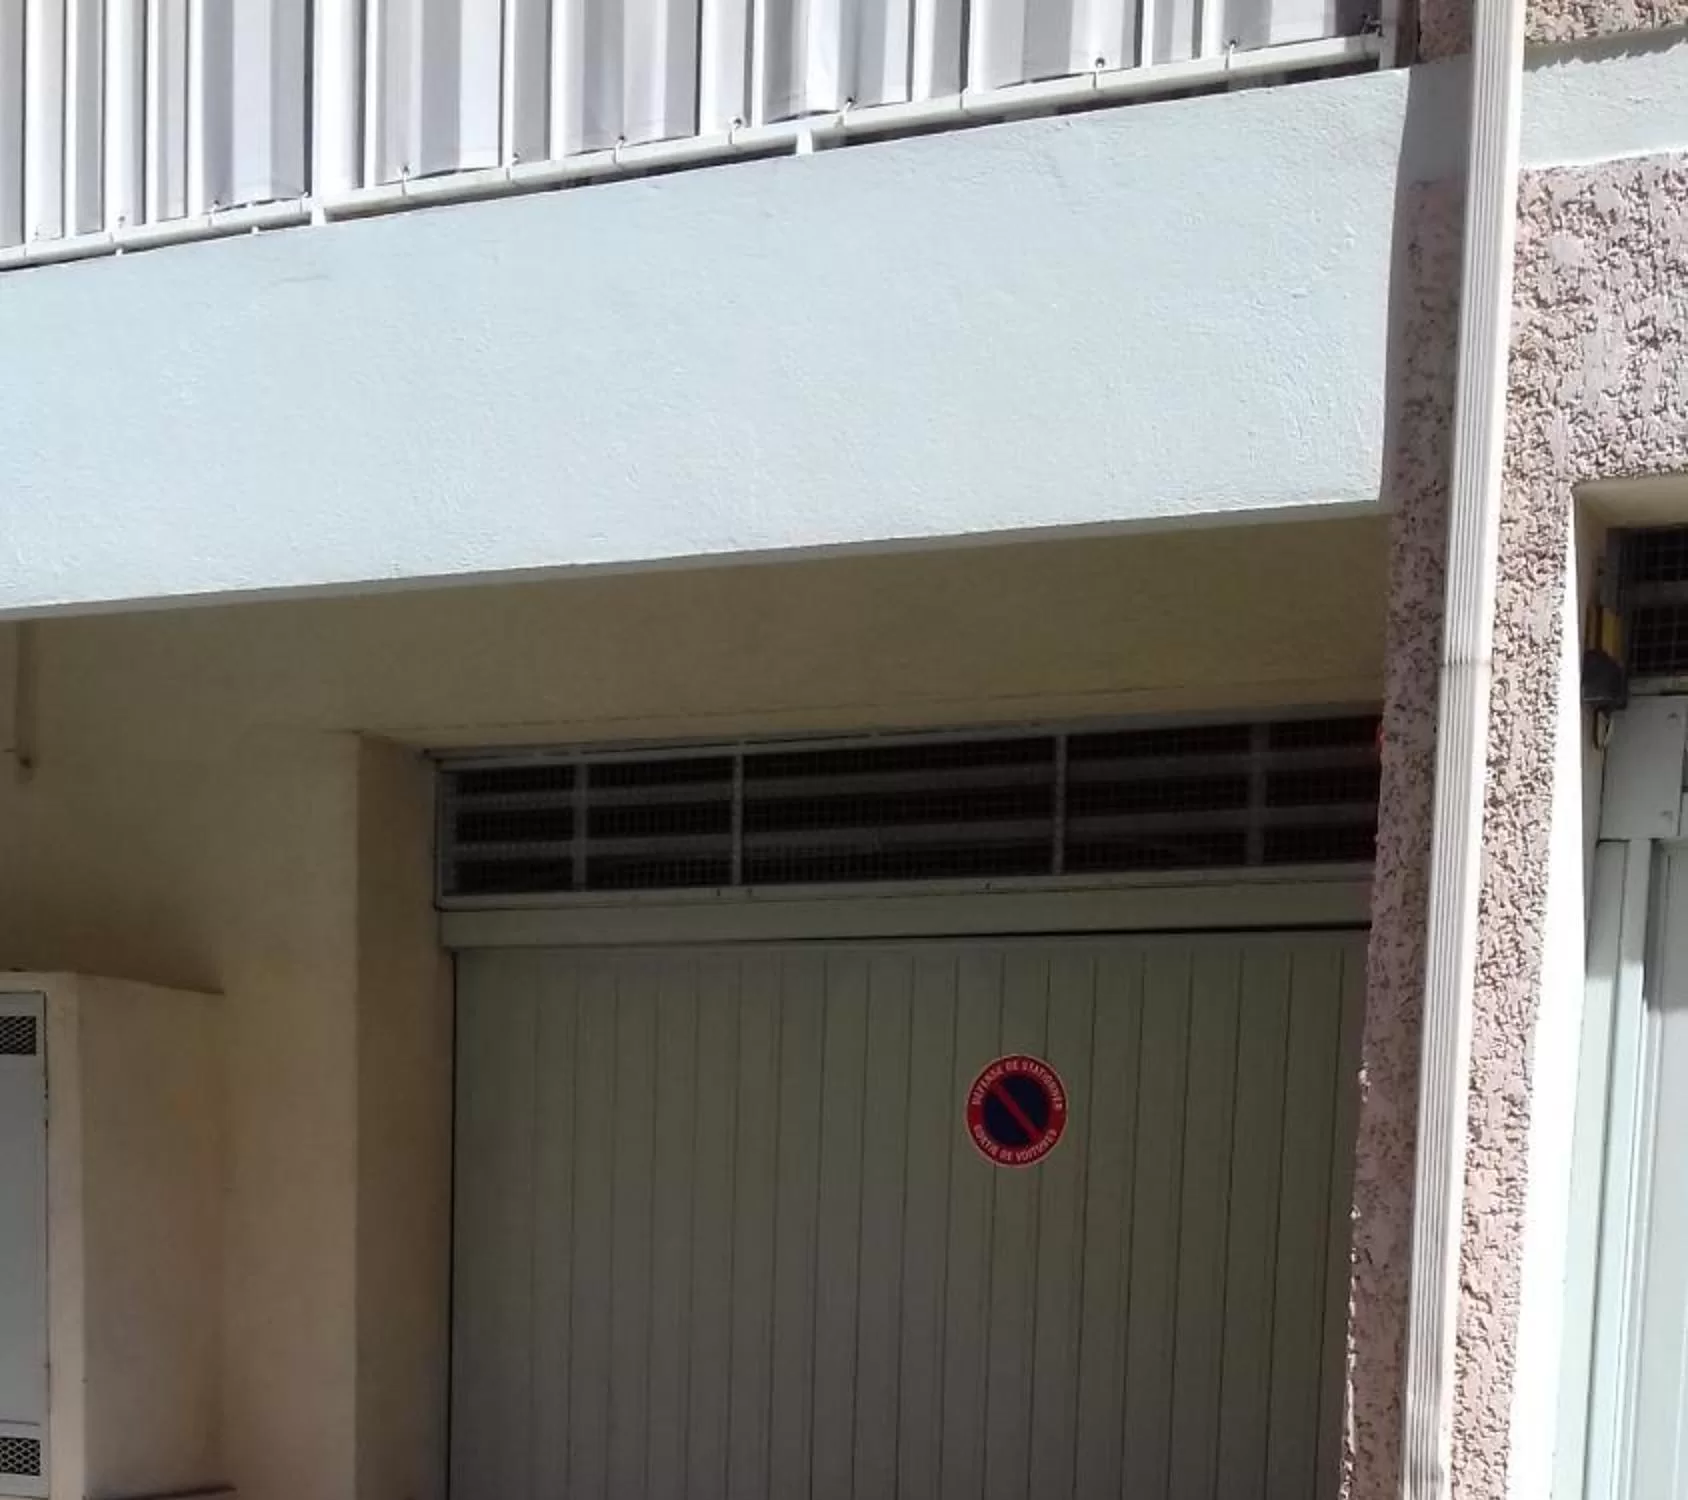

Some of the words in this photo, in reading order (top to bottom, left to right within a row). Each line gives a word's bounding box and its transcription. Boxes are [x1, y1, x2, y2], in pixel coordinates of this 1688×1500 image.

[1005, 1060, 1018, 1071] DE
[1021, 1060, 1063, 1111] STATIONNER
[973, 1124, 1000, 1157] SORTIE
[999, 1150, 1012, 1161] DE
